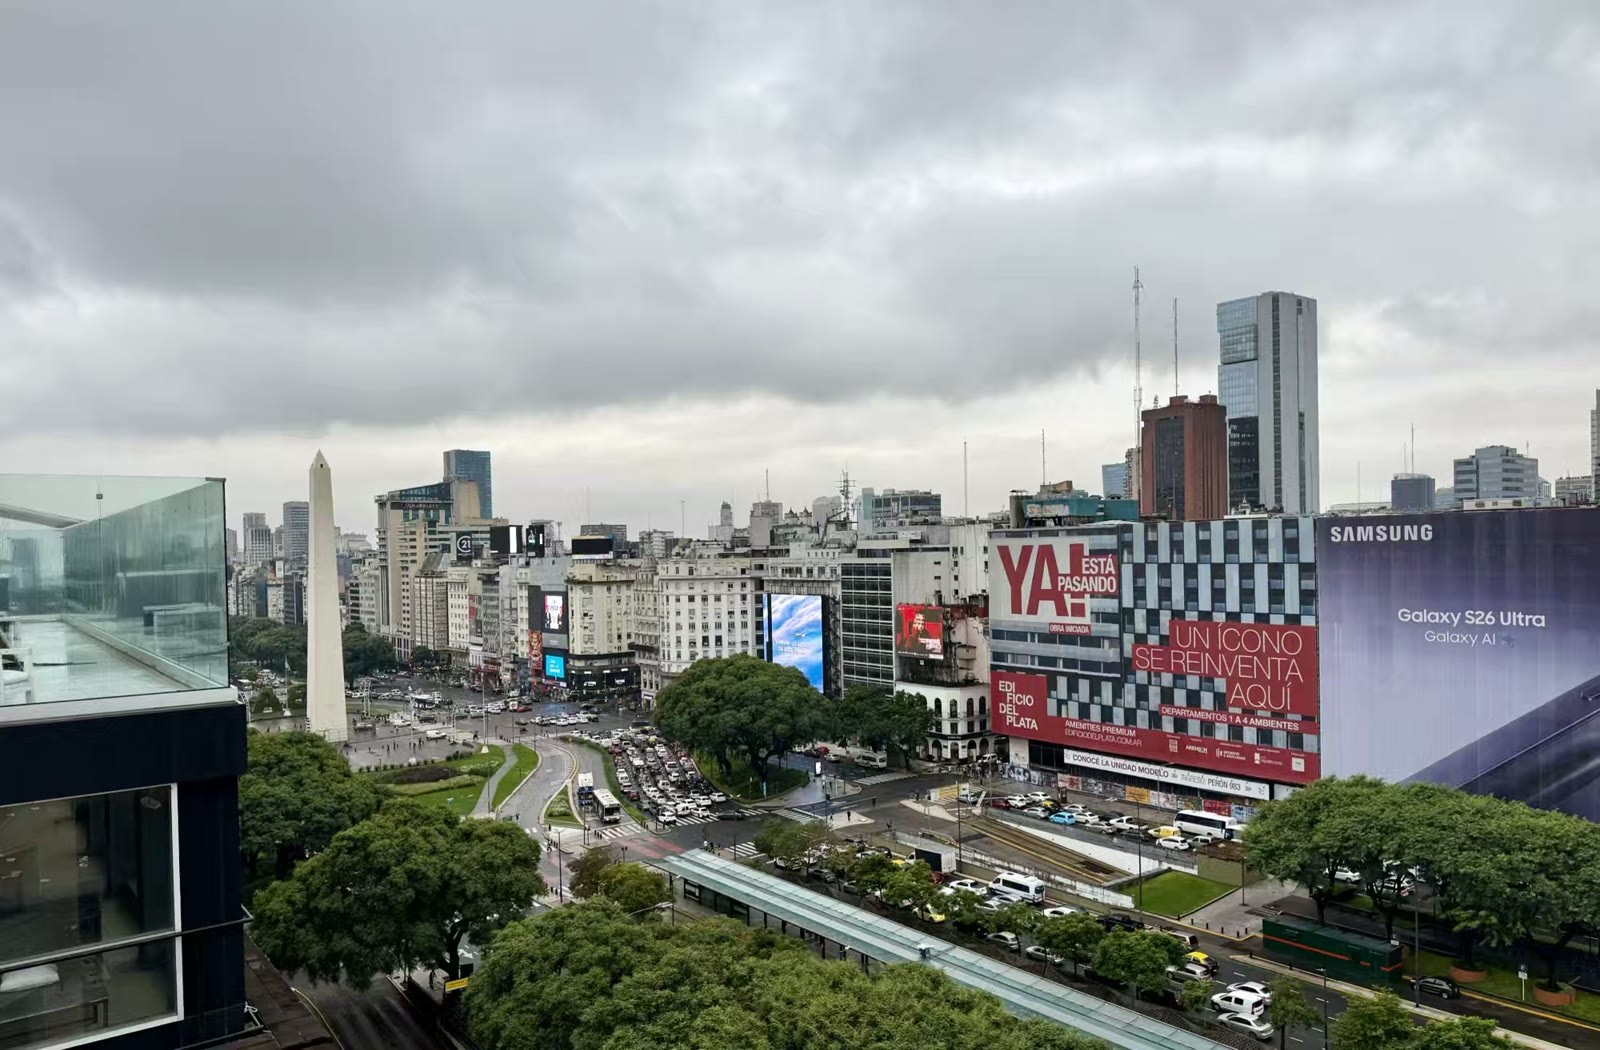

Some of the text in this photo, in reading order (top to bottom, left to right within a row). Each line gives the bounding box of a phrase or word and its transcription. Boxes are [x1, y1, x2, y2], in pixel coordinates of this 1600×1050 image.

[1331, 524, 1433, 542] SAMSUNG
[1082, 554, 1115, 575] ESTÁ
[997, 543, 1086, 618] YA!
[1058, 576, 1116, 593] PASANDO
[1398, 608, 1545, 627] Galaxy S26 Ultra
[1049, 624, 1090, 634] OBRA INICIADA
[1176, 622, 1302, 655] UN ÍCONO
[1425, 630, 1496, 647] Galaxy AI
[1135, 647, 1304, 683] SE REINVENTA
[999, 680, 1015, 693] EDI
[1006, 692, 1034, 706] FICIO
[1229, 682, 1291, 710] AQUÍ
[999, 703, 1019, 716] DEL
[1161, 706, 1227, 722] DEPARTAMENTOS
[1235, 716, 1241, 724] A
[1249, 718, 1299, 731] AMBIENTES
[1006, 715, 1038, 731] PLATA
[1065, 720, 1136, 737] AMENITIES PREMIUM
[1101, 759, 1110, 767] LA
[1111, 761, 1137, 772] UNIDAD
[1138, 766, 1169, 778] MODELO
